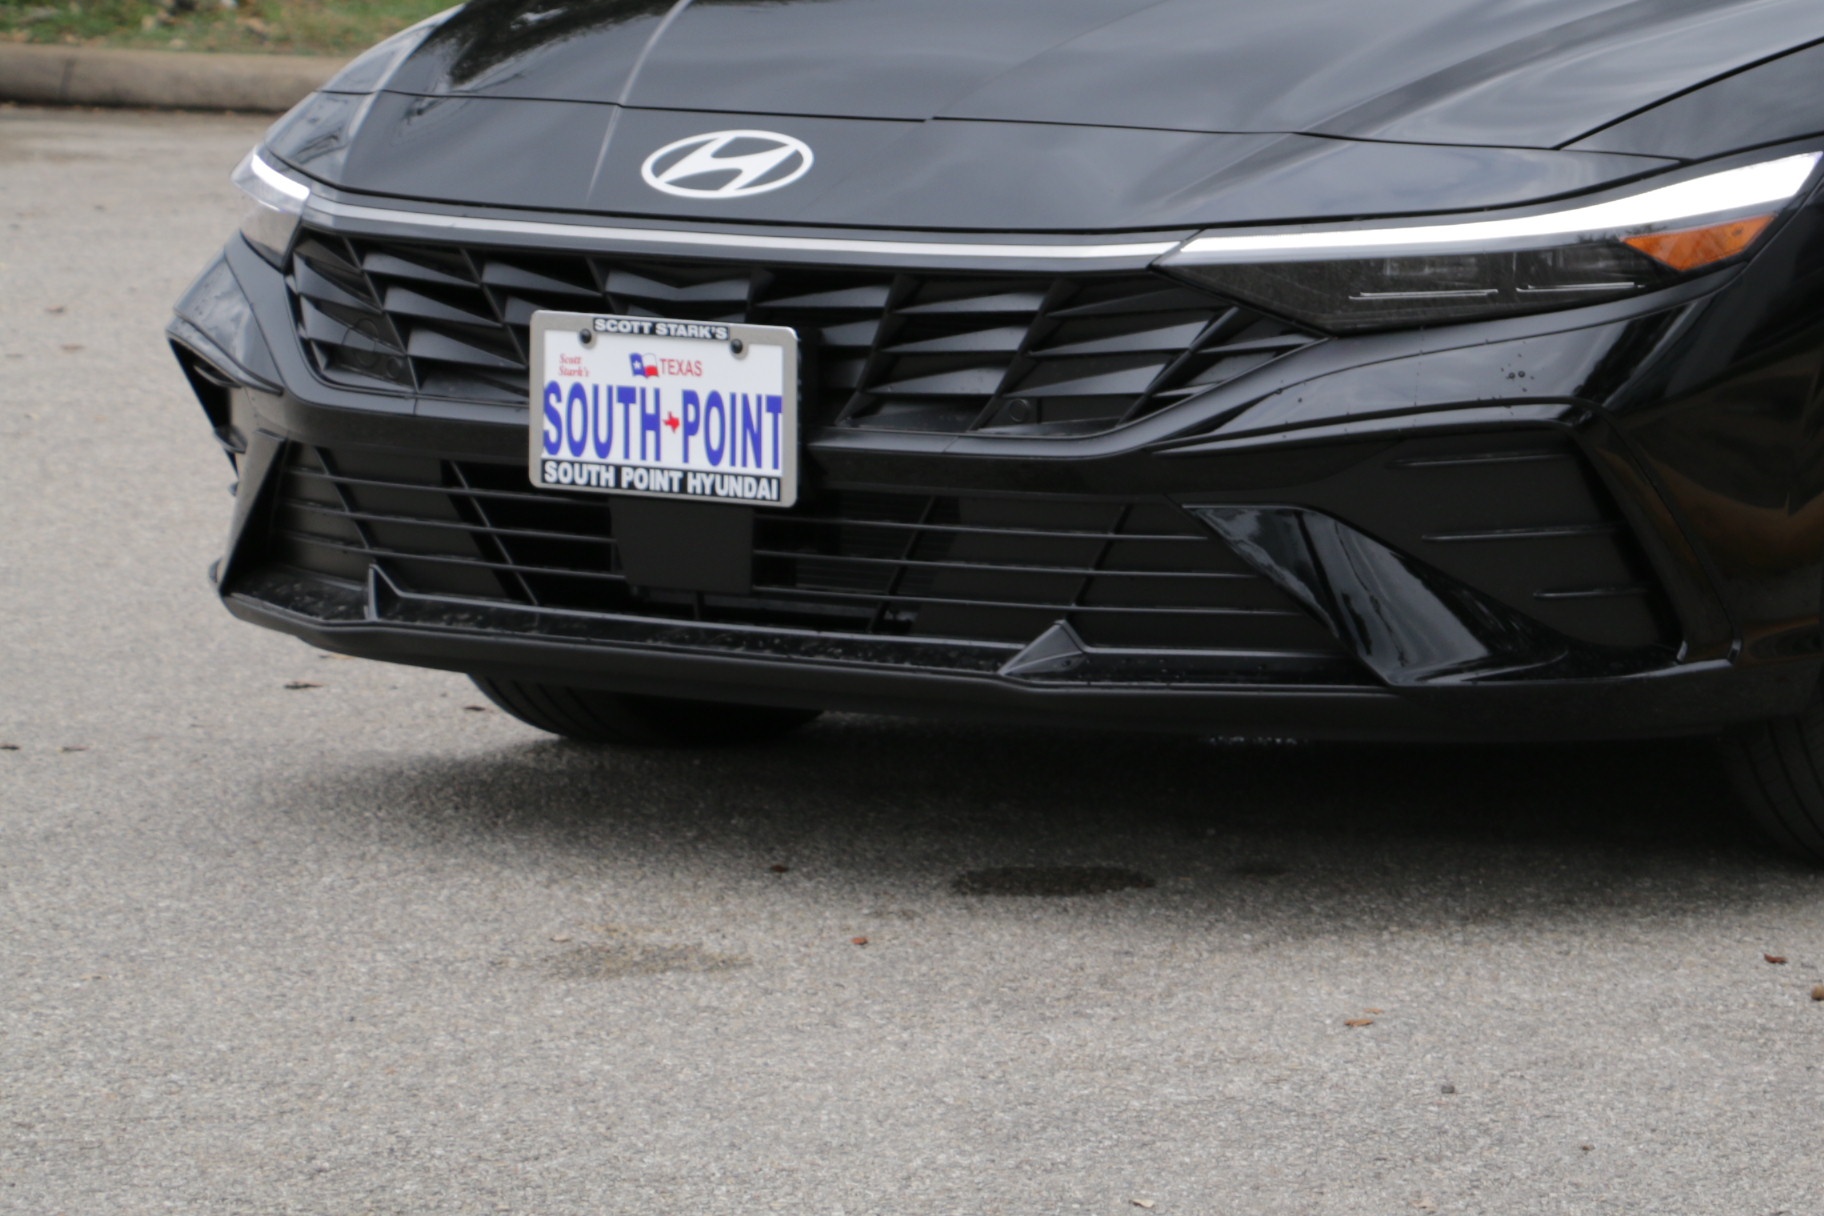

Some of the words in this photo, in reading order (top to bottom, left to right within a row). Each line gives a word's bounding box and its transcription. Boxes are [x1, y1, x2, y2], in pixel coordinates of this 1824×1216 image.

[594, 318, 652, 334] SCOTT
[655, 323, 728, 340] STARK'S
[560, 354, 582, 365] Scott
[659, 358, 703, 377] TEXAS
[559, 366, 589, 377] Stark's
[544, 381, 661, 462] SOUTH
[682, 389, 782, 470] POINT
[544, 461, 614, 488] SOUTH
[621, 467, 684, 493] POINT
[687, 472, 778, 501] HYUNDAI
